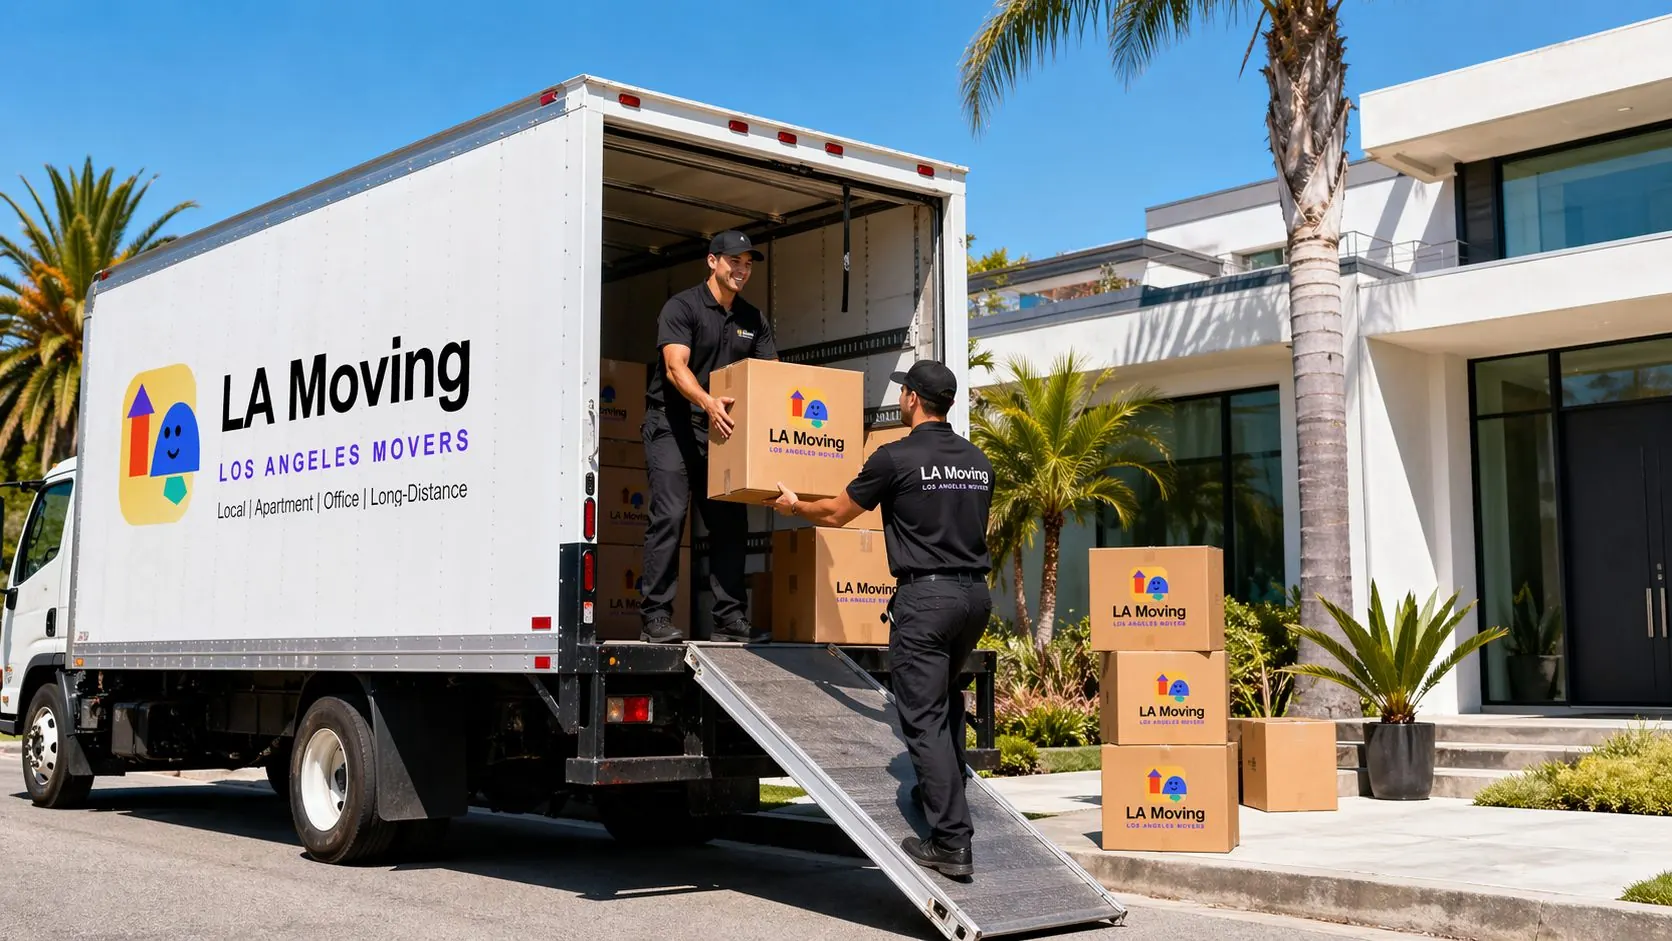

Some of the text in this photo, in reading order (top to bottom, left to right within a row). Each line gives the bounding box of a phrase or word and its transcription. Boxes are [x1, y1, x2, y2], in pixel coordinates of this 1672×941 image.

[222, 335, 471, 432] LA Moving
[769, 428, 845, 452] LA Moving
[219, 428, 469, 482] LOS ANGELES MOVERS
[920, 465, 989, 484] LA Moving
[217, 483, 468, 519] Local Apartment Office Long-Distance
[836, 581, 853, 594] LA
[1113, 605, 1186, 620] LA Moving
[1139, 706, 1205, 719] LA Moving
[1126, 806, 1205, 823] LA Moving
